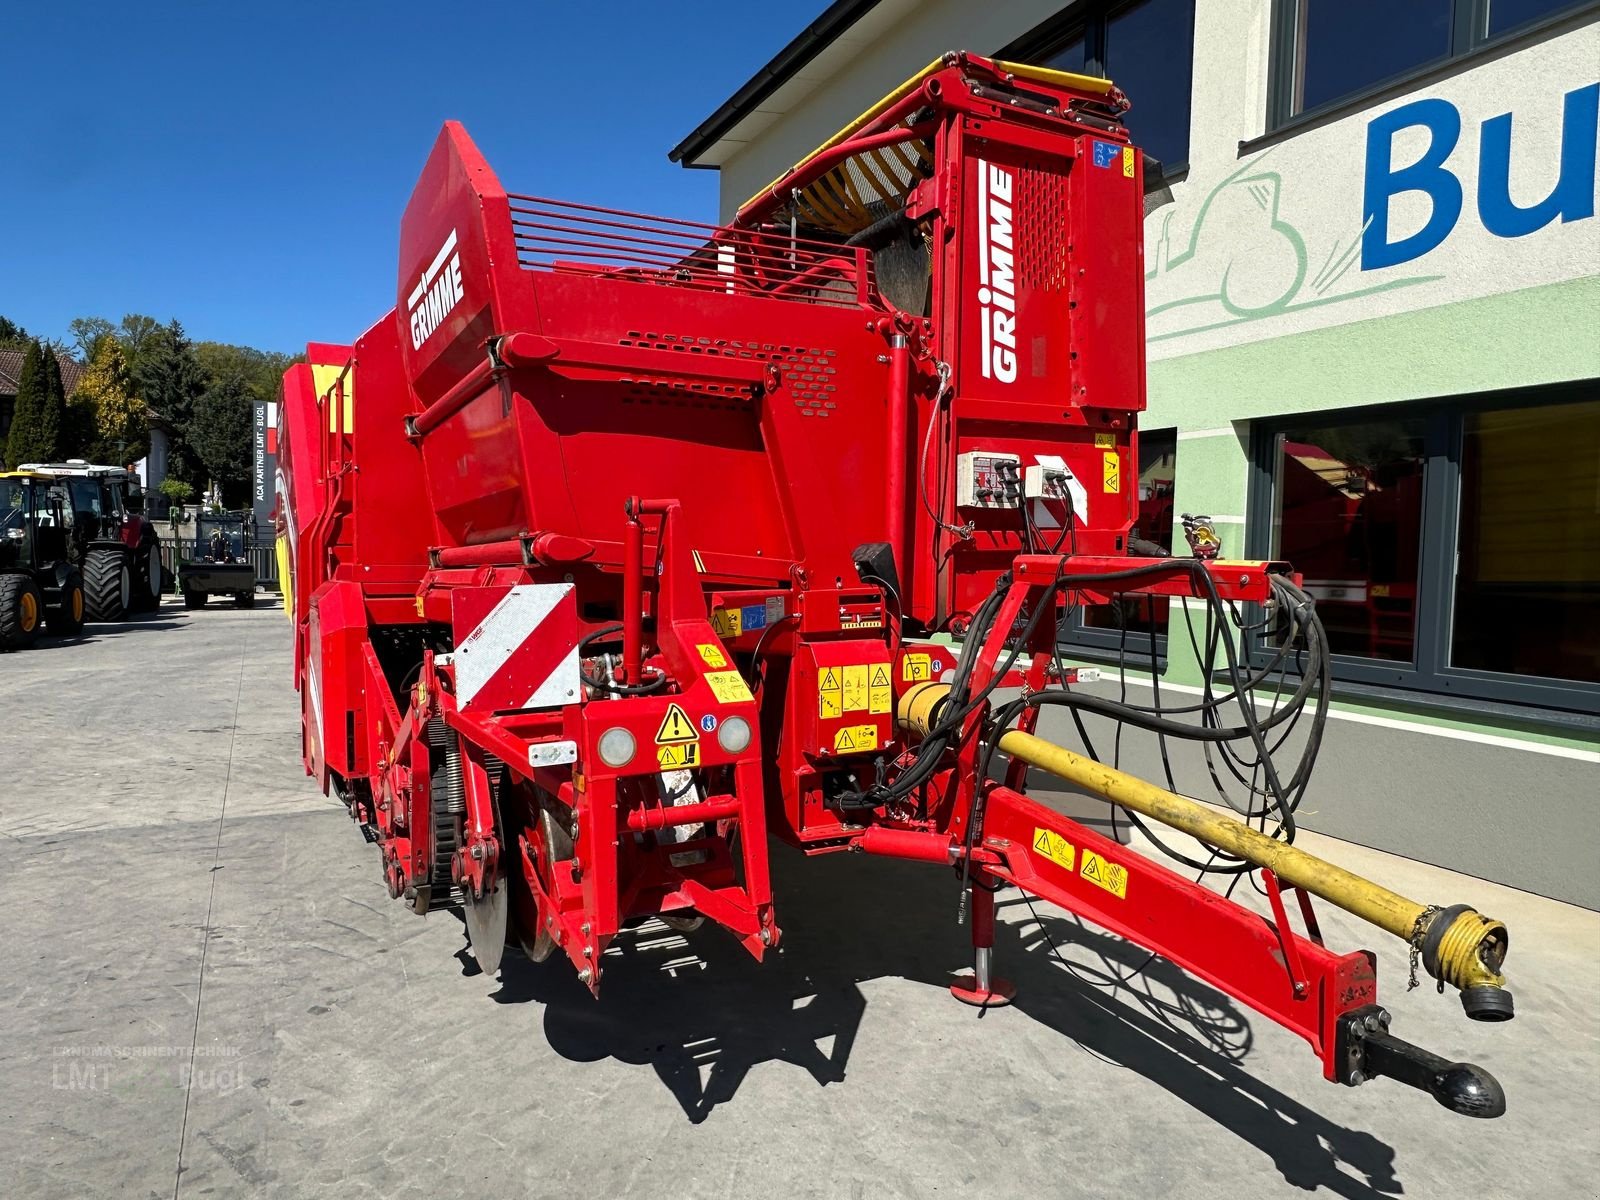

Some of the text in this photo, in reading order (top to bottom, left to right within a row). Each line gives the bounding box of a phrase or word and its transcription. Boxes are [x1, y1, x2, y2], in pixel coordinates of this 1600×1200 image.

[1361, 82, 1600, 271] Bu
[256, 405, 264, 427] BUGL
[256, 432, 264, 448] LMT
[256, 448, 264, 483] PARTNER
[256, 484, 264, 501] ACA
